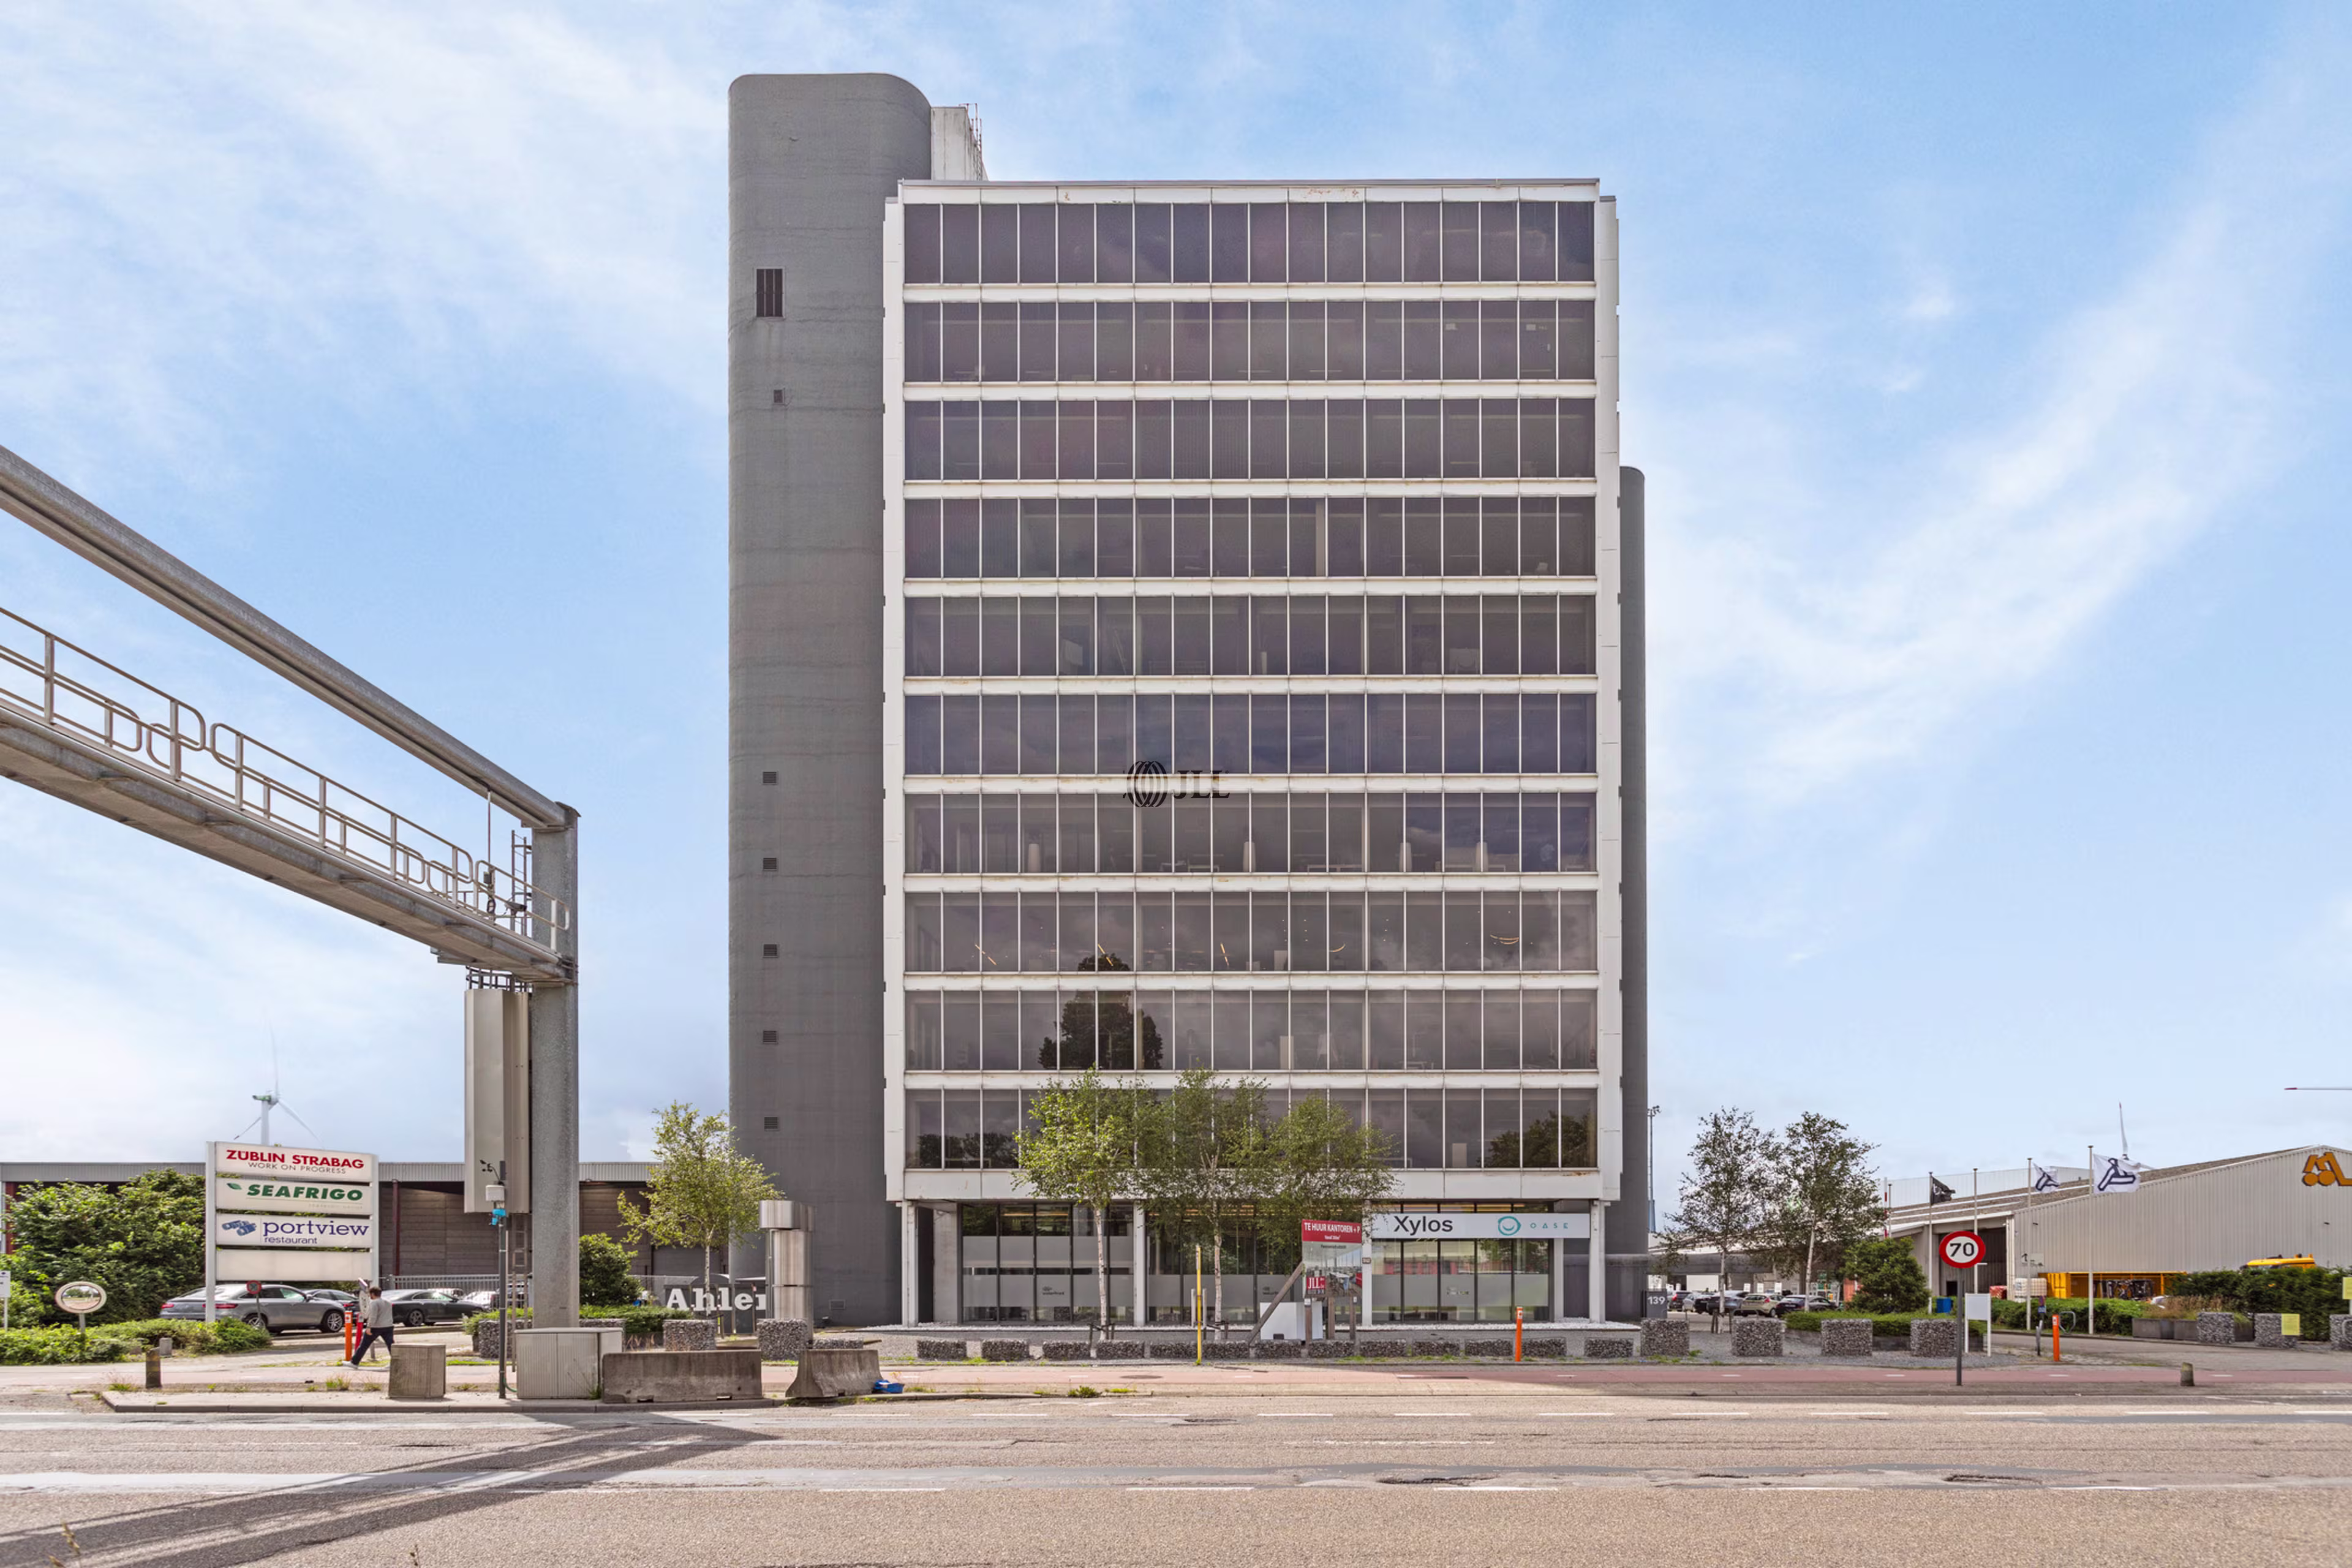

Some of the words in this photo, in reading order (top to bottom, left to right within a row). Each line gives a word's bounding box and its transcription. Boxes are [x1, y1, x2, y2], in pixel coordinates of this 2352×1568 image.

[292, 1155, 364, 1169] STRABAG
[300, 1166, 347, 1174] PROGRESS
[246, 1184, 363, 1201] SEAFRIGO
[262, 1220, 369, 1237] portview
[1304, 1223, 1311, 1231] TE
[1312, 1223, 1327, 1232] HUUR
[1327, 1224, 1353, 1233] KANTOREN
[1393, 1215, 1453, 1236] Xylos
[264, 1236, 317, 1245] restaurant
[1950, 1242, 1974, 1257] 70
[1307, 1277, 1321, 1289] JLL
[1648, 1295, 1666, 1305] 139
